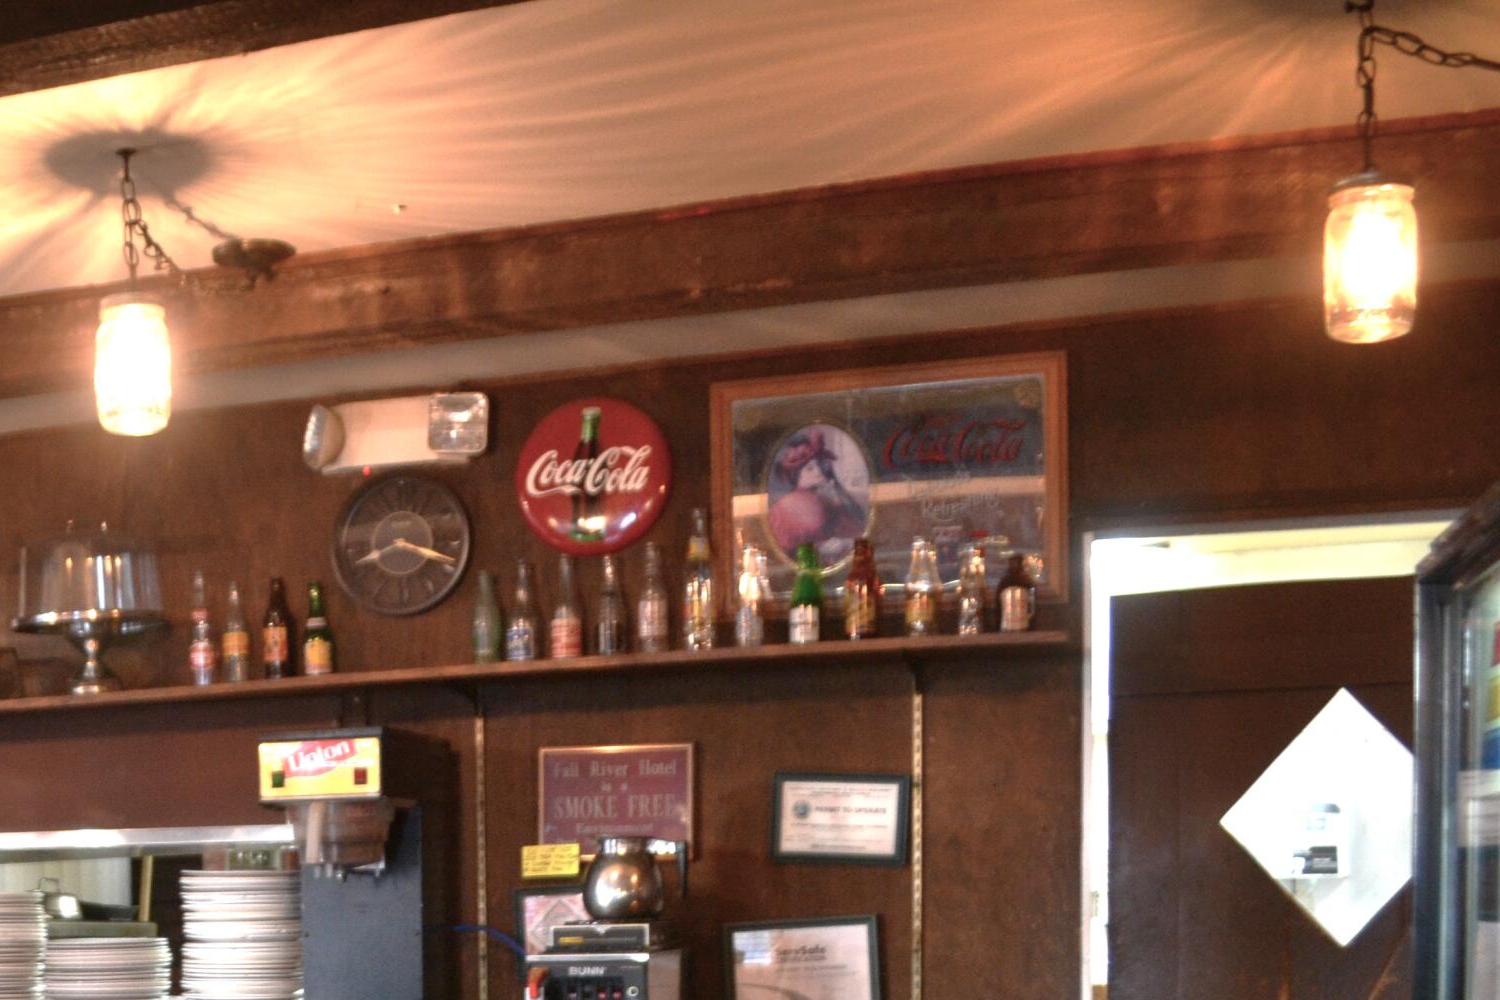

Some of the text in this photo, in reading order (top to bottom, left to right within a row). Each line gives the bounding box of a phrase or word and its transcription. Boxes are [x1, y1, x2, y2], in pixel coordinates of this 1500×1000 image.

[554, 758, 677, 778] Fall River Hotel
[554, 793, 676, 818] SMOKE FREE
[568, 966, 605, 975] BUNN
